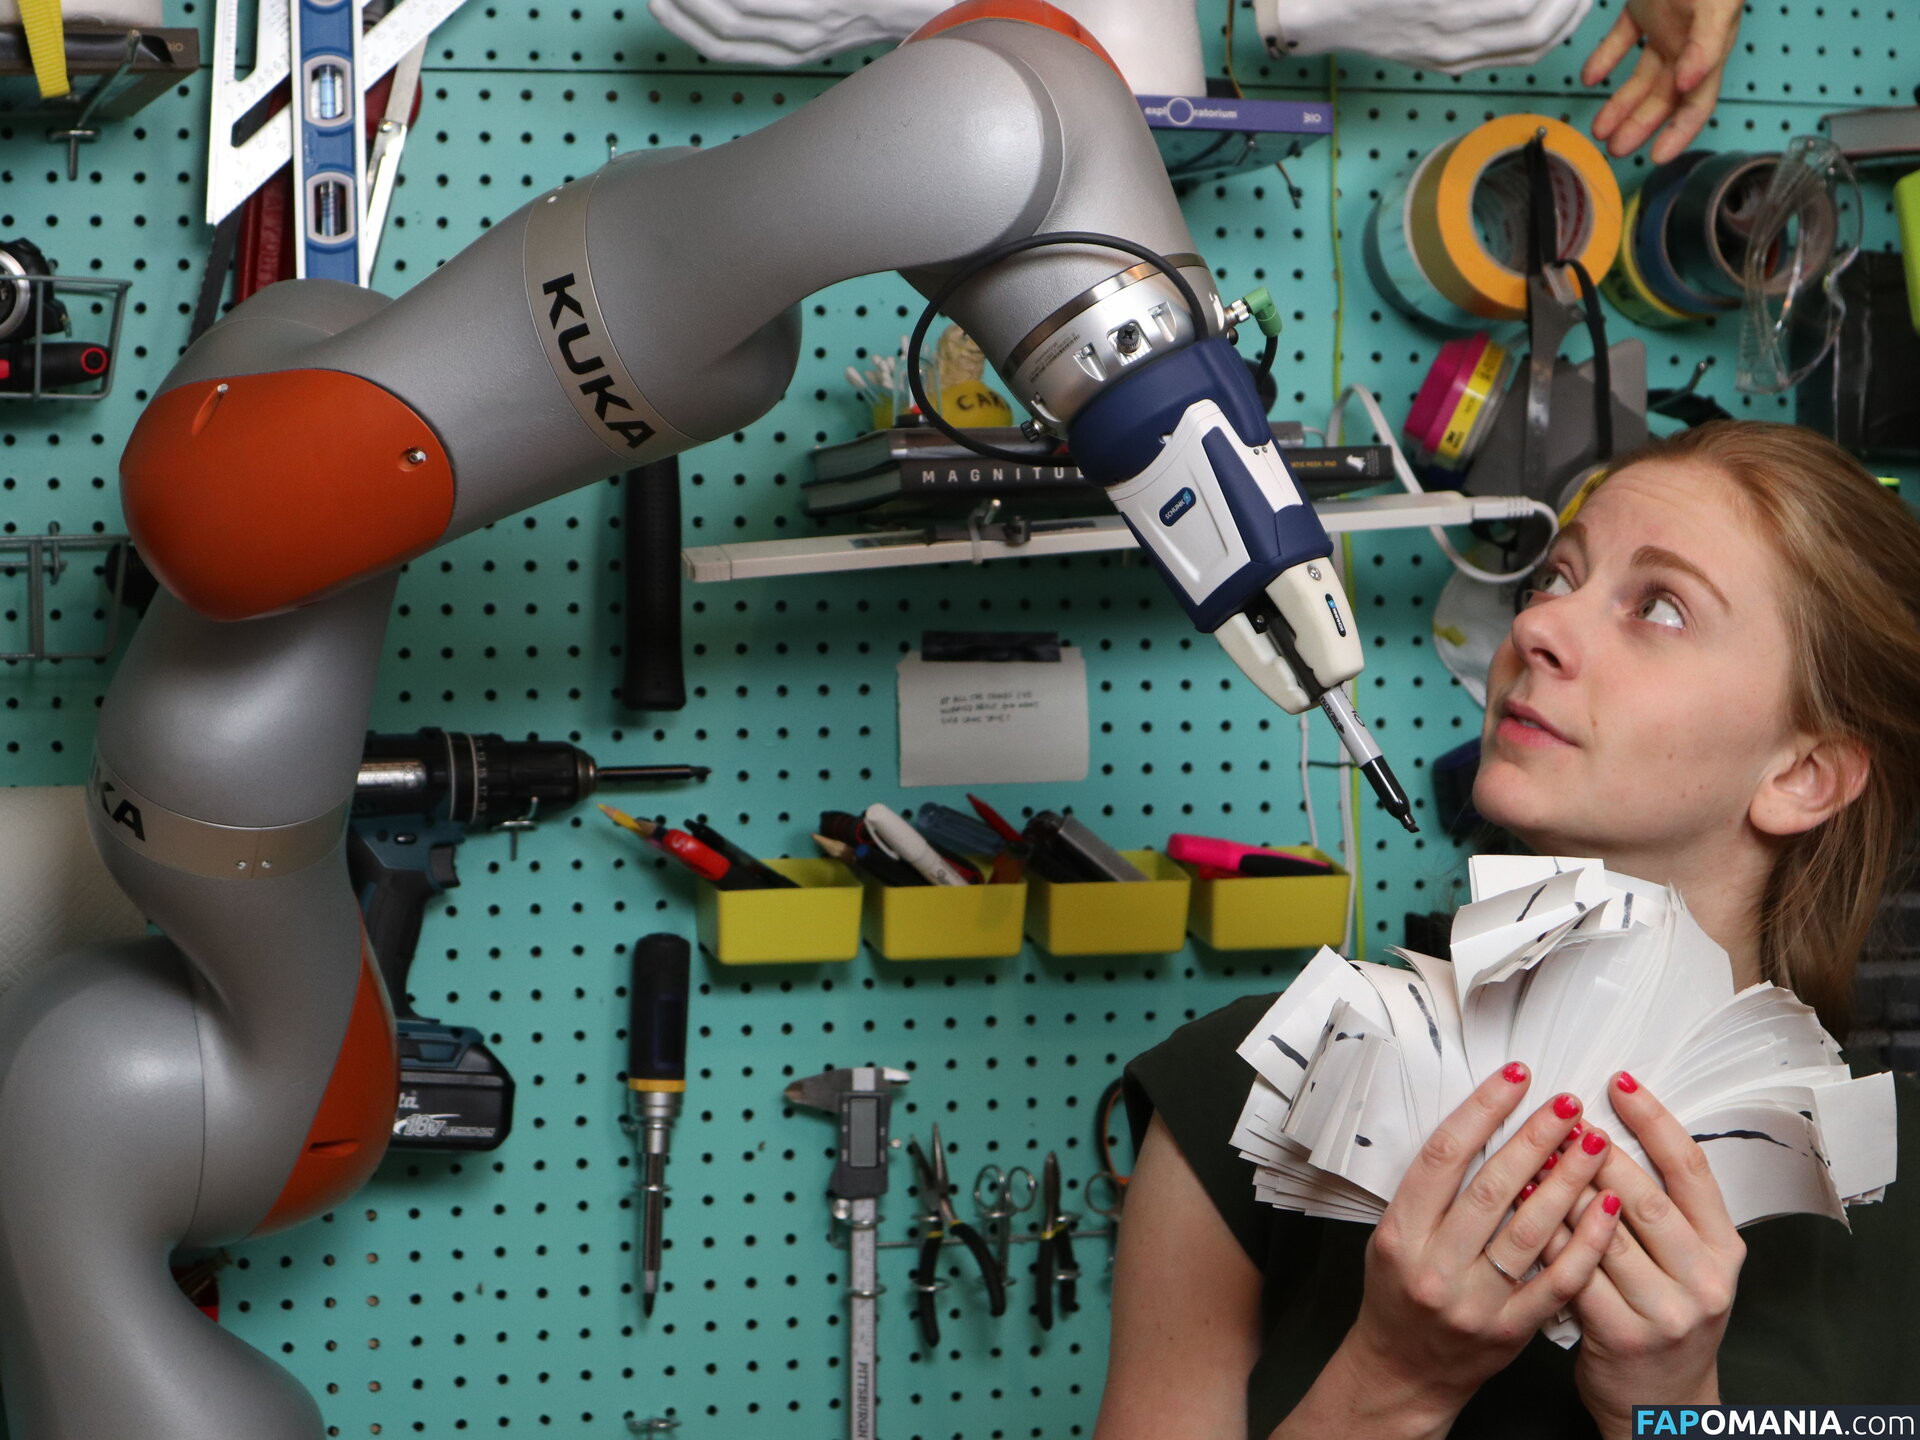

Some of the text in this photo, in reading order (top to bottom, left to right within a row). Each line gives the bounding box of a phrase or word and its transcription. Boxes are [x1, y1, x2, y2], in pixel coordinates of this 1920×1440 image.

[542, 272, 656, 449] KUKA
[1164, 499, 1186, 520] SCHUNK
[856, 1361, 869, 1439] PITTSBURGH
